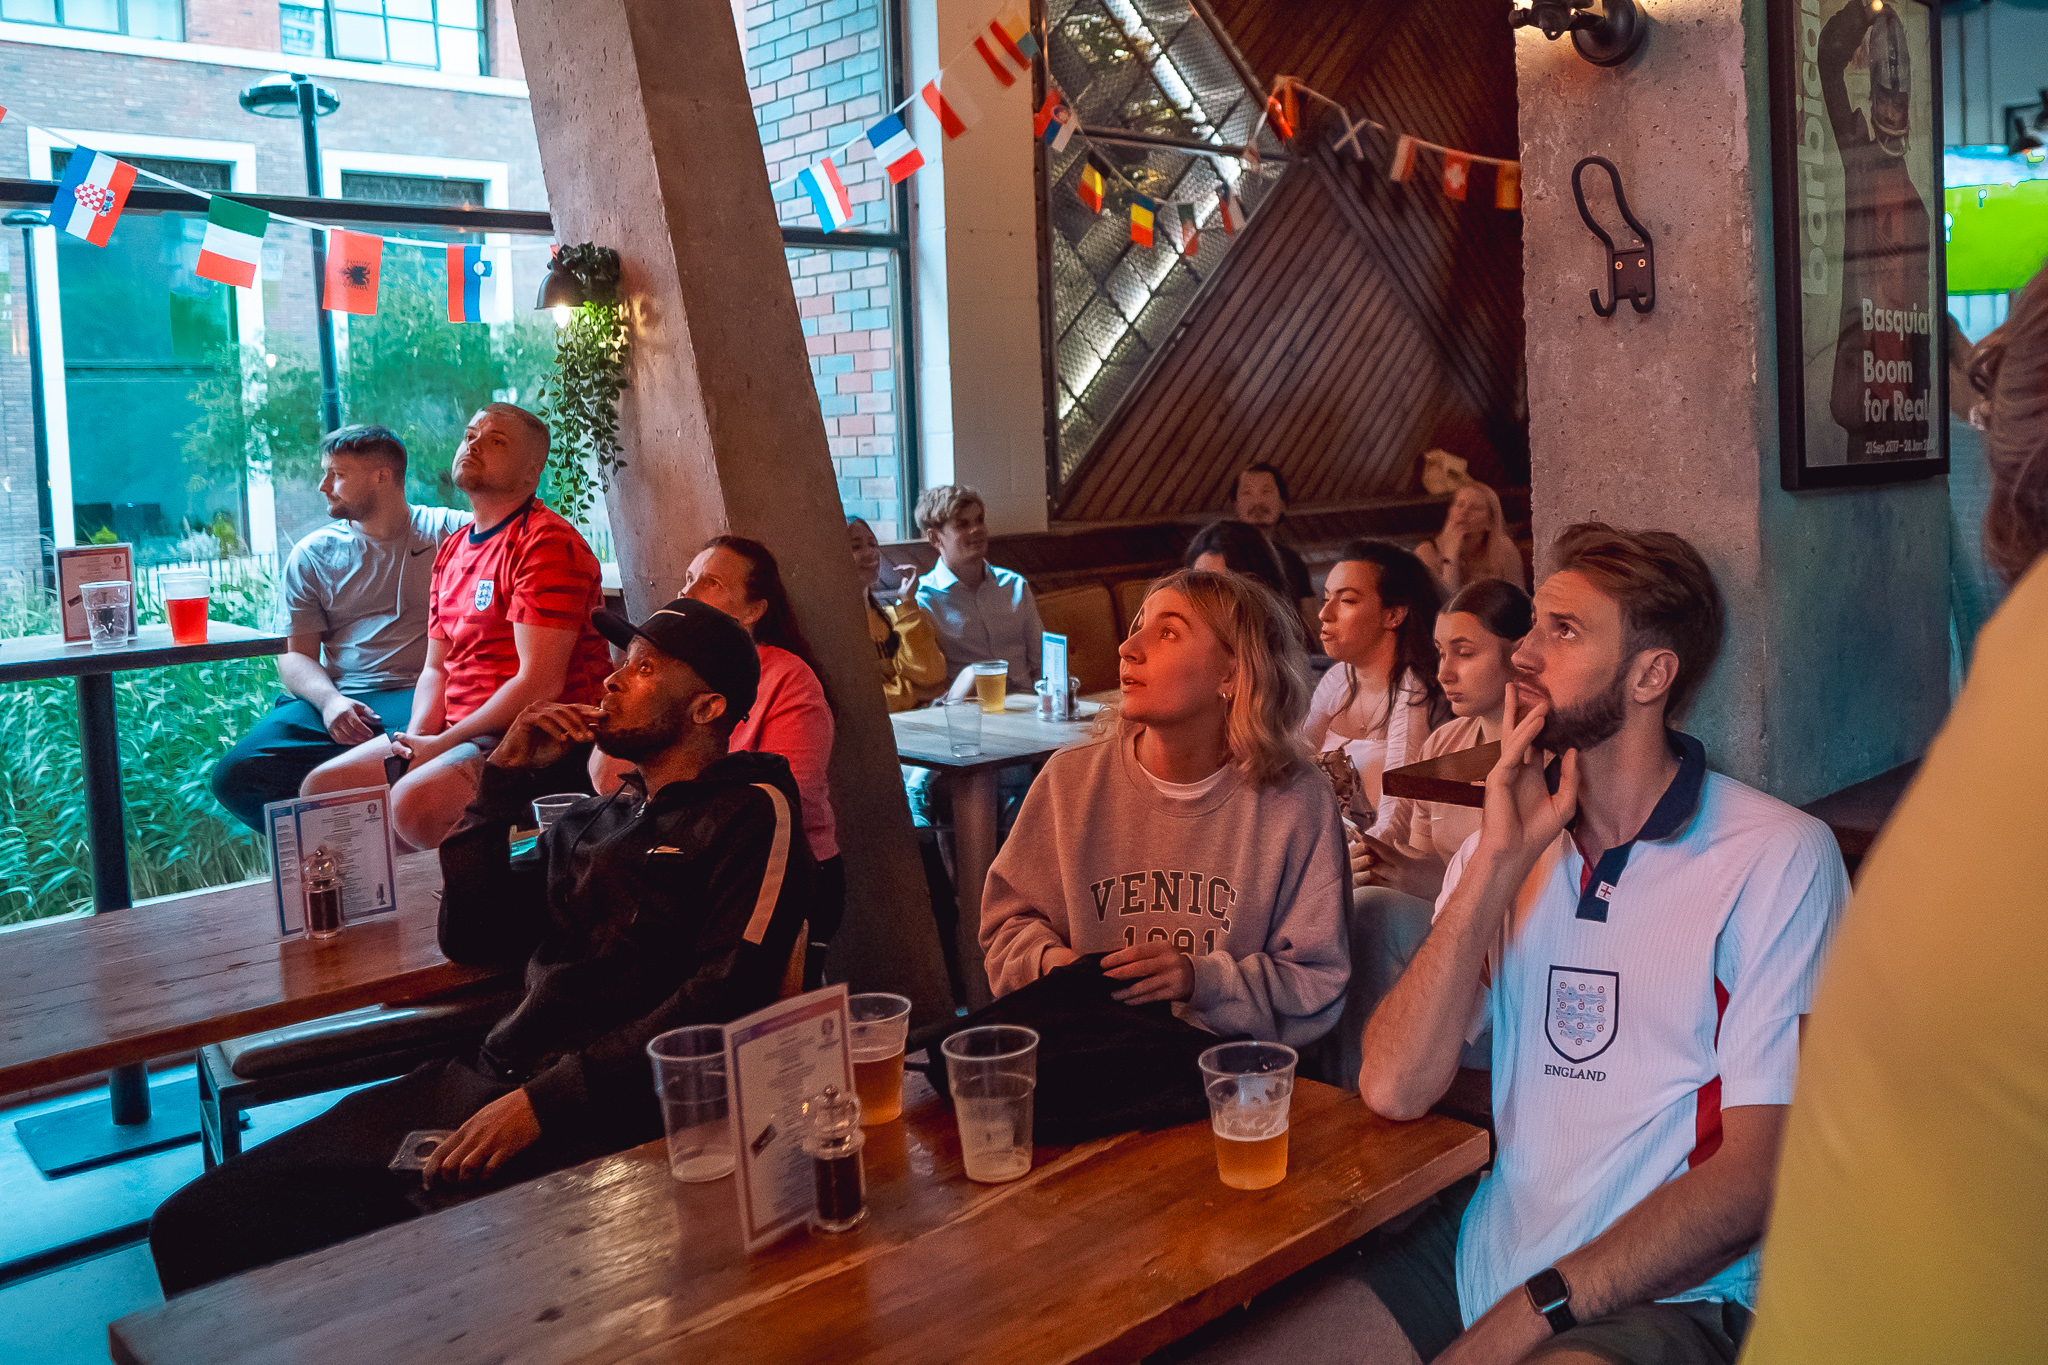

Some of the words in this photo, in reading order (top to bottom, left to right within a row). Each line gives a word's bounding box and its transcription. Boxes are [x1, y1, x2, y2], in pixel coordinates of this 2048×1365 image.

[1863, 350, 1913, 384] Boom
[1864, 388, 1890, 423] for
[1893, 389, 1929, 422] Real
[1873, 440, 1886, 456] Sep
[1544, 1064, 1607, 1082] ENGLAND
